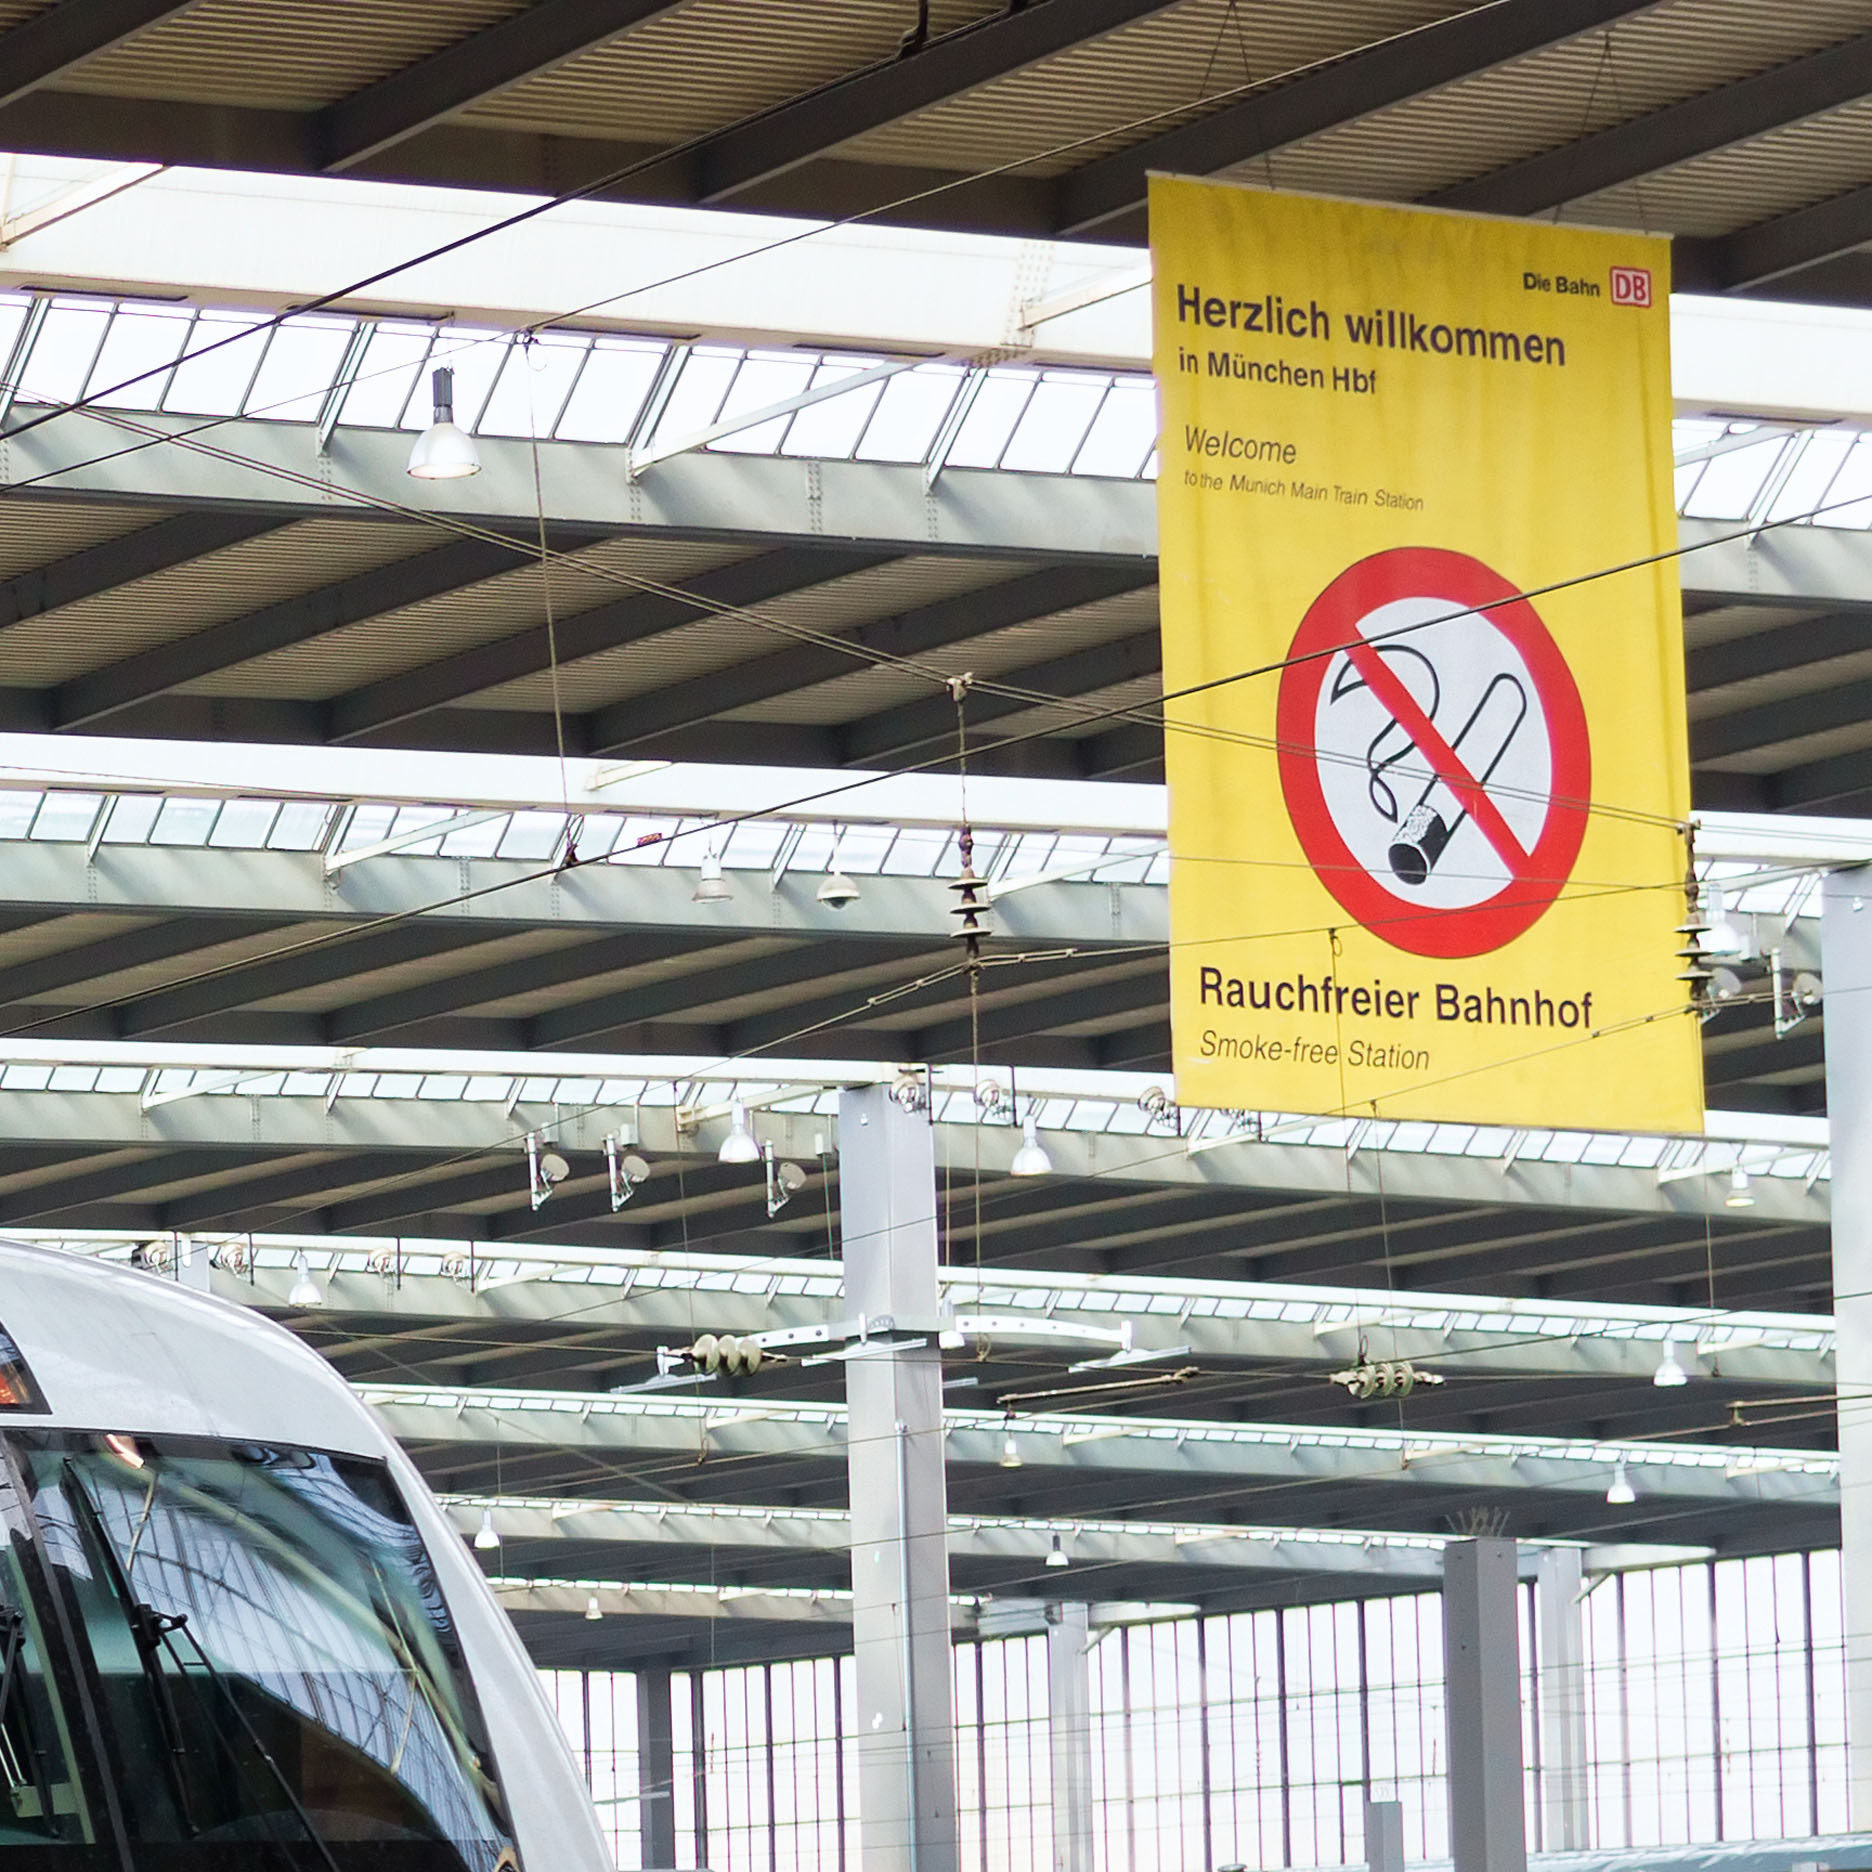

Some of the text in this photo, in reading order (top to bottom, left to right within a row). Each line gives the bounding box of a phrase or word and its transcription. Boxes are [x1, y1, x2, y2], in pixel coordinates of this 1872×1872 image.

[1523, 271, 1649, 303] Die Bahn DB
[1177, 283, 1565, 366] Herzlich willkommen
[1179, 346, 1376, 394] in München Hbf
[1185, 425, 1297, 464] Welcome
[1184, 470, 1424, 511] to the Munich Main Train Station
[1200, 966, 1592, 1029] Rauchfreier Bahnhof
[1200, 1030, 1430, 1071] Smoke-free Station
